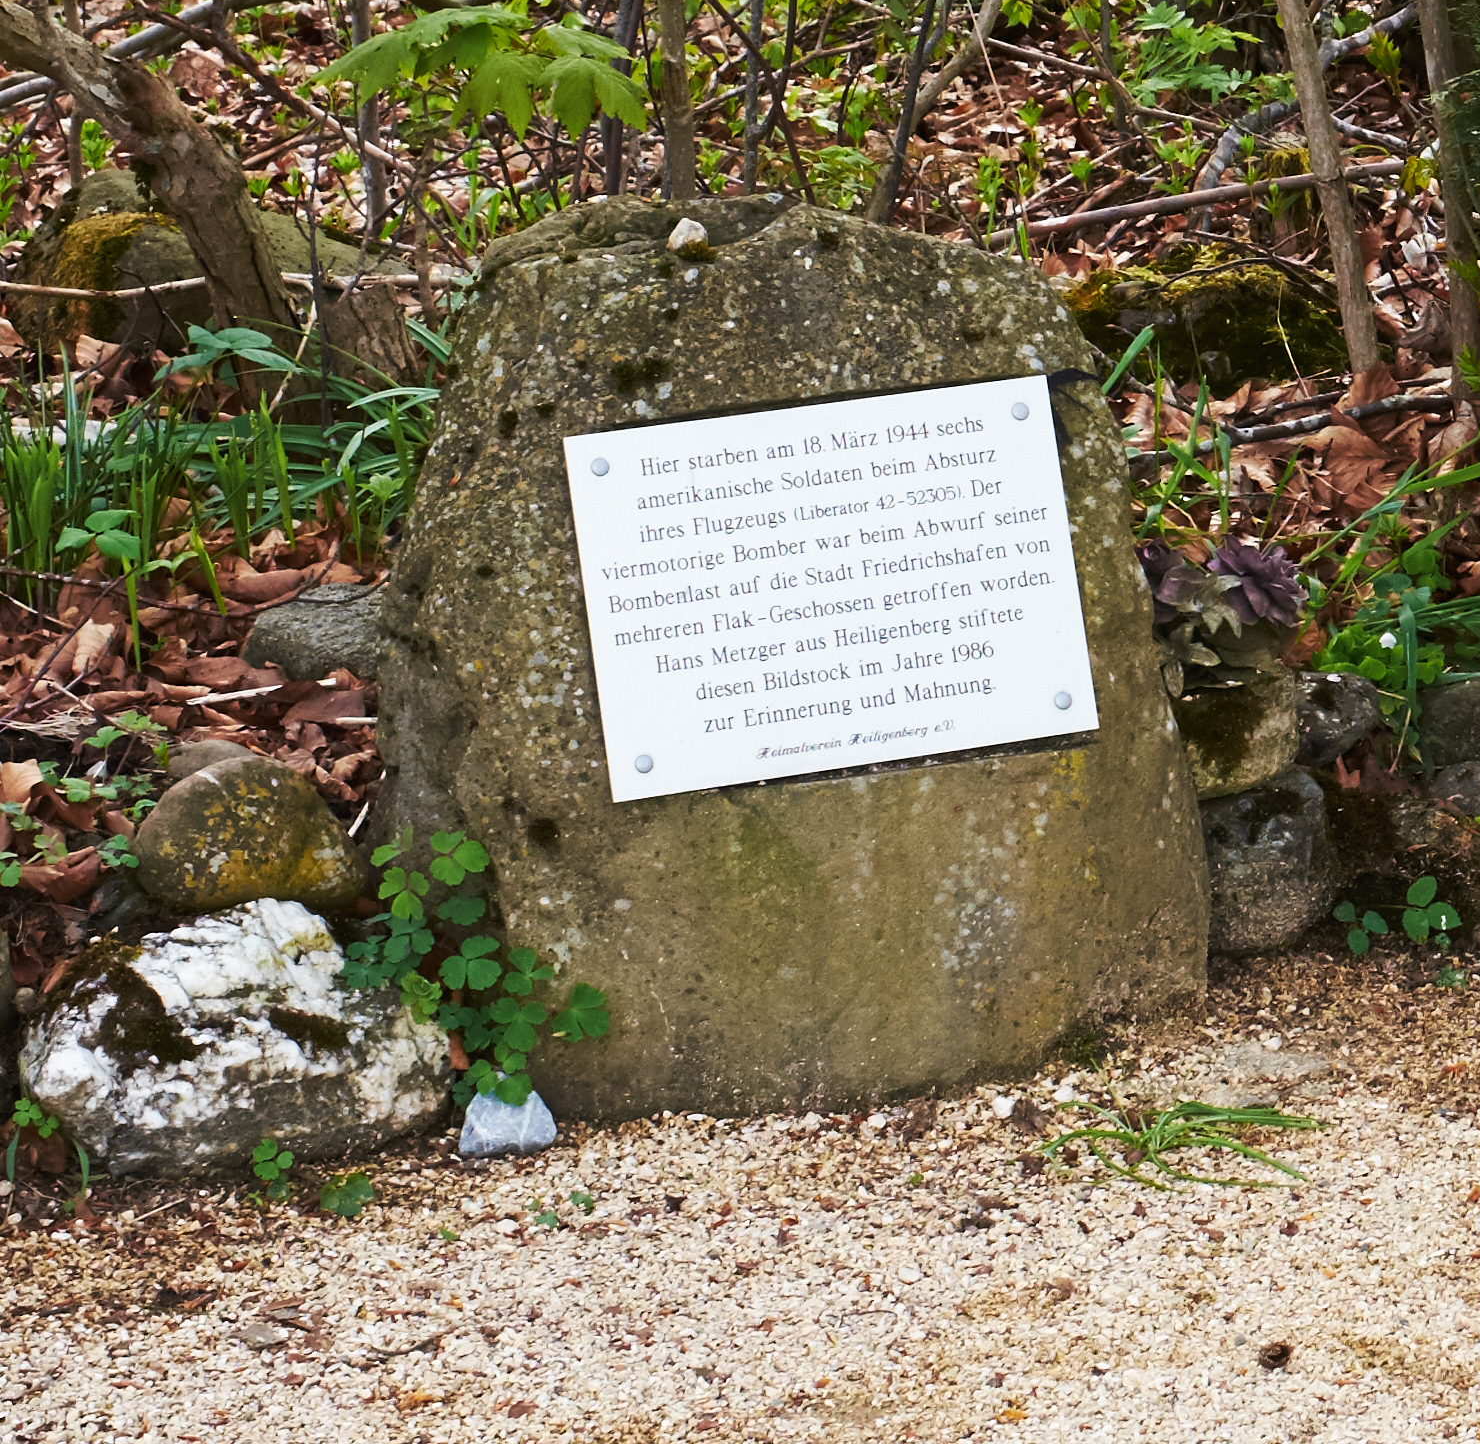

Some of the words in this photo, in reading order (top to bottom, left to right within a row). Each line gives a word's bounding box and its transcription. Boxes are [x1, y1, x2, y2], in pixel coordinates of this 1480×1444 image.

[639, 456, 680, 477] Hier
[688, 447, 759, 471] starben
[766, 444, 796, 460] am
[802, 435, 827, 456] 18.
[830, 430, 879, 452] März
[885, 421, 930, 444] 1944
[936, 416, 984, 437] sechs
[637, 477, 774, 510] amerikanische
[780, 467, 864, 491] Soldaten
[869, 457, 918, 478] beim
[924, 449, 997, 472] Absturz
[639, 524, 685, 544] ihres
[692, 510, 787, 536] Flugzeugs
[793, 501, 870, 522] (Liberator
[875, 485, 966, 511] 42-52305).
[969, 479, 1003, 498] Der
[600, 550, 726, 581] viermotorige
[731, 539, 807, 564] Bomber
[814, 534, 852, 551] war
[858, 524, 906, 545] beim
[913, 510, 986, 539] Abwurf
[993, 506, 1048, 527] seiner
[607, 584, 722, 614] Bombenlast
[729, 575, 761, 597] auf
[769, 571, 799, 591] die
[804, 563, 855, 586] Stadt
[860, 543, 1008, 578] Friedrichshafen
[1014, 539, 1051, 556] von
[613, 621, 705, 647] mehreren
[711, 596, 876, 633] Flak-Geschossen
[882, 581, 973, 611] getroffen
[979, 569, 1056, 592] worden.
[654, 654, 704, 674] Hans
[710, 642, 787, 666] Metzger
[795, 636, 827, 654] aus
[833, 618, 953, 648] Heiligenberg
[958, 607, 1024, 630] stiftete
[695, 680, 756, 701] diesen
[762, 661, 852, 692] Bildstock
[858, 659, 884, 678] im
[891, 651, 944, 673] Jahre
[951, 640, 995, 664] 1986
[703, 716, 735, 734] zur
[742, 698, 853, 728] Erinnerung
[859, 687, 897, 710] und
[902, 678, 997, 704] Mahnung.
[847, 726, 929, 746] Heiligenberg
[933, 719, 956, 733] e.V.
